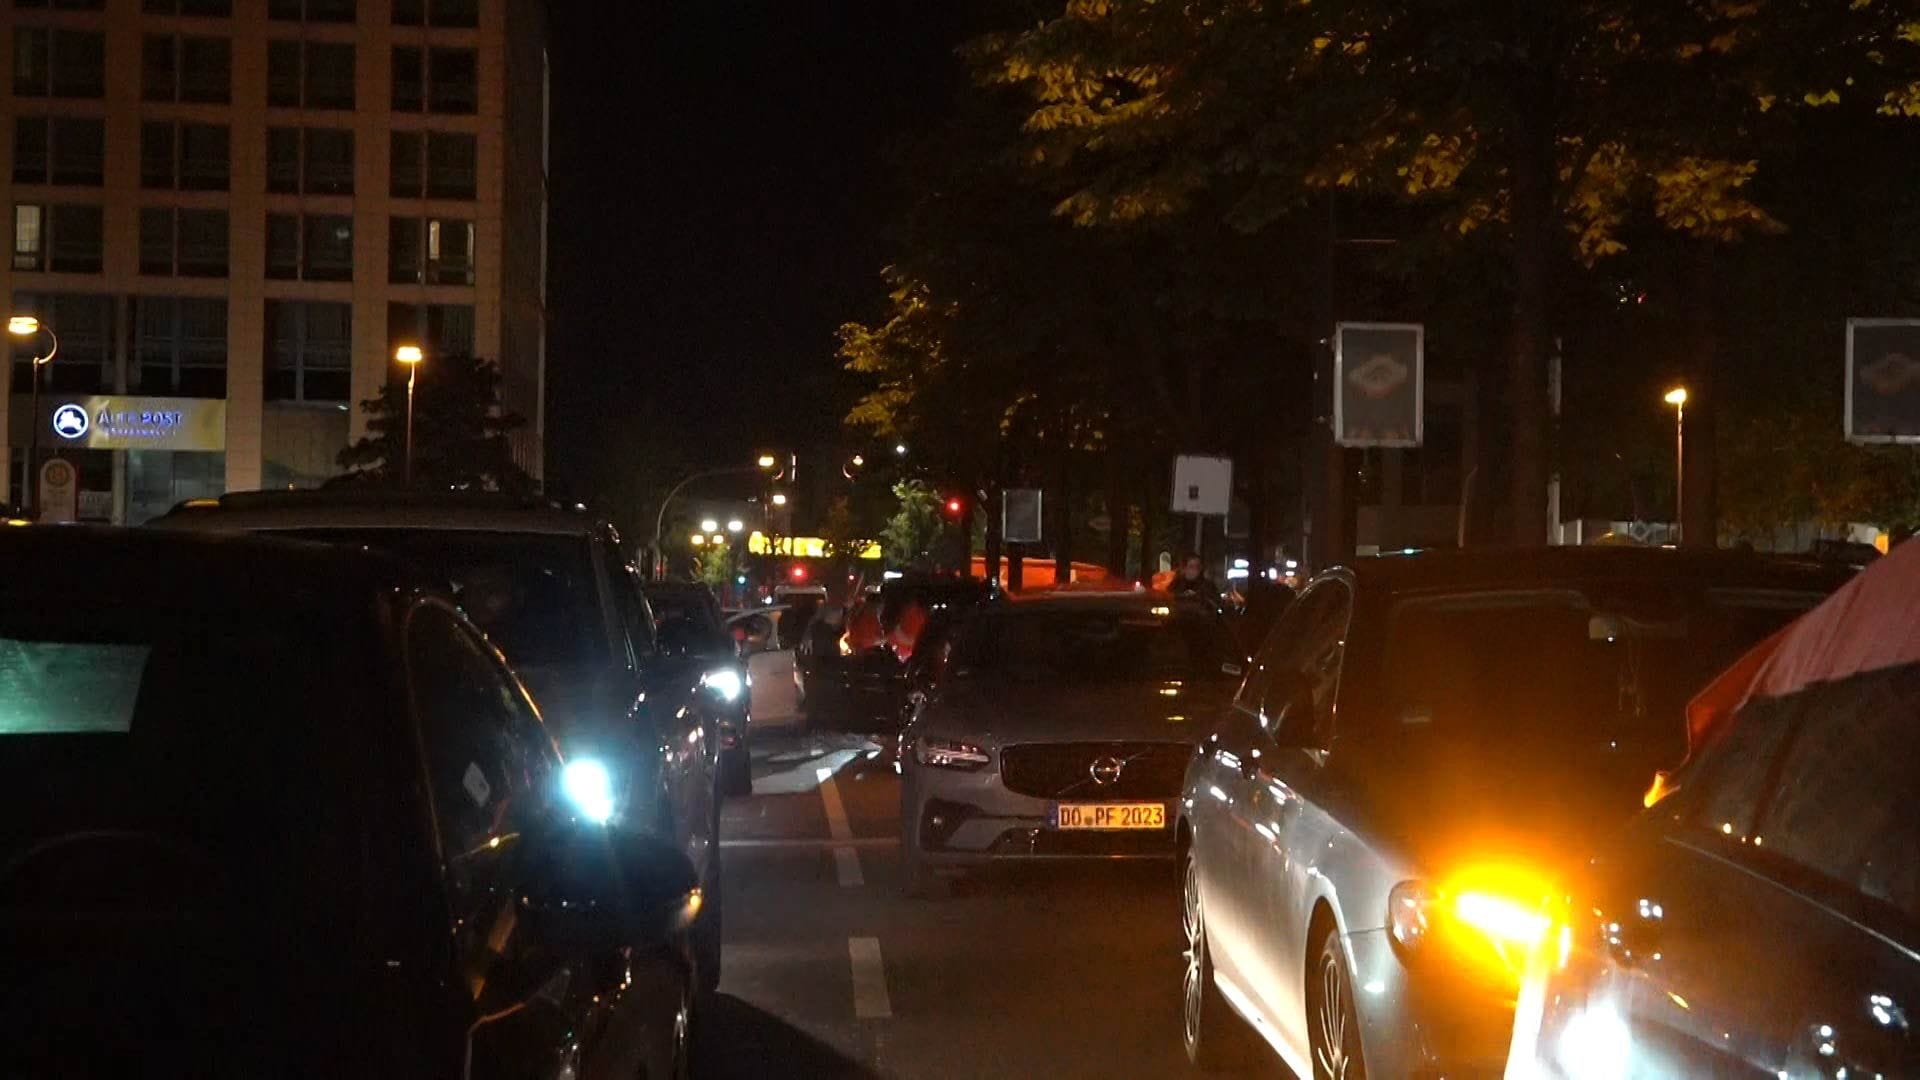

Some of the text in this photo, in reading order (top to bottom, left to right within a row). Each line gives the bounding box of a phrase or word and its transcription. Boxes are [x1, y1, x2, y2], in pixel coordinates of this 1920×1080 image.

[1060, 807, 1163, 826] DO PF 2023
